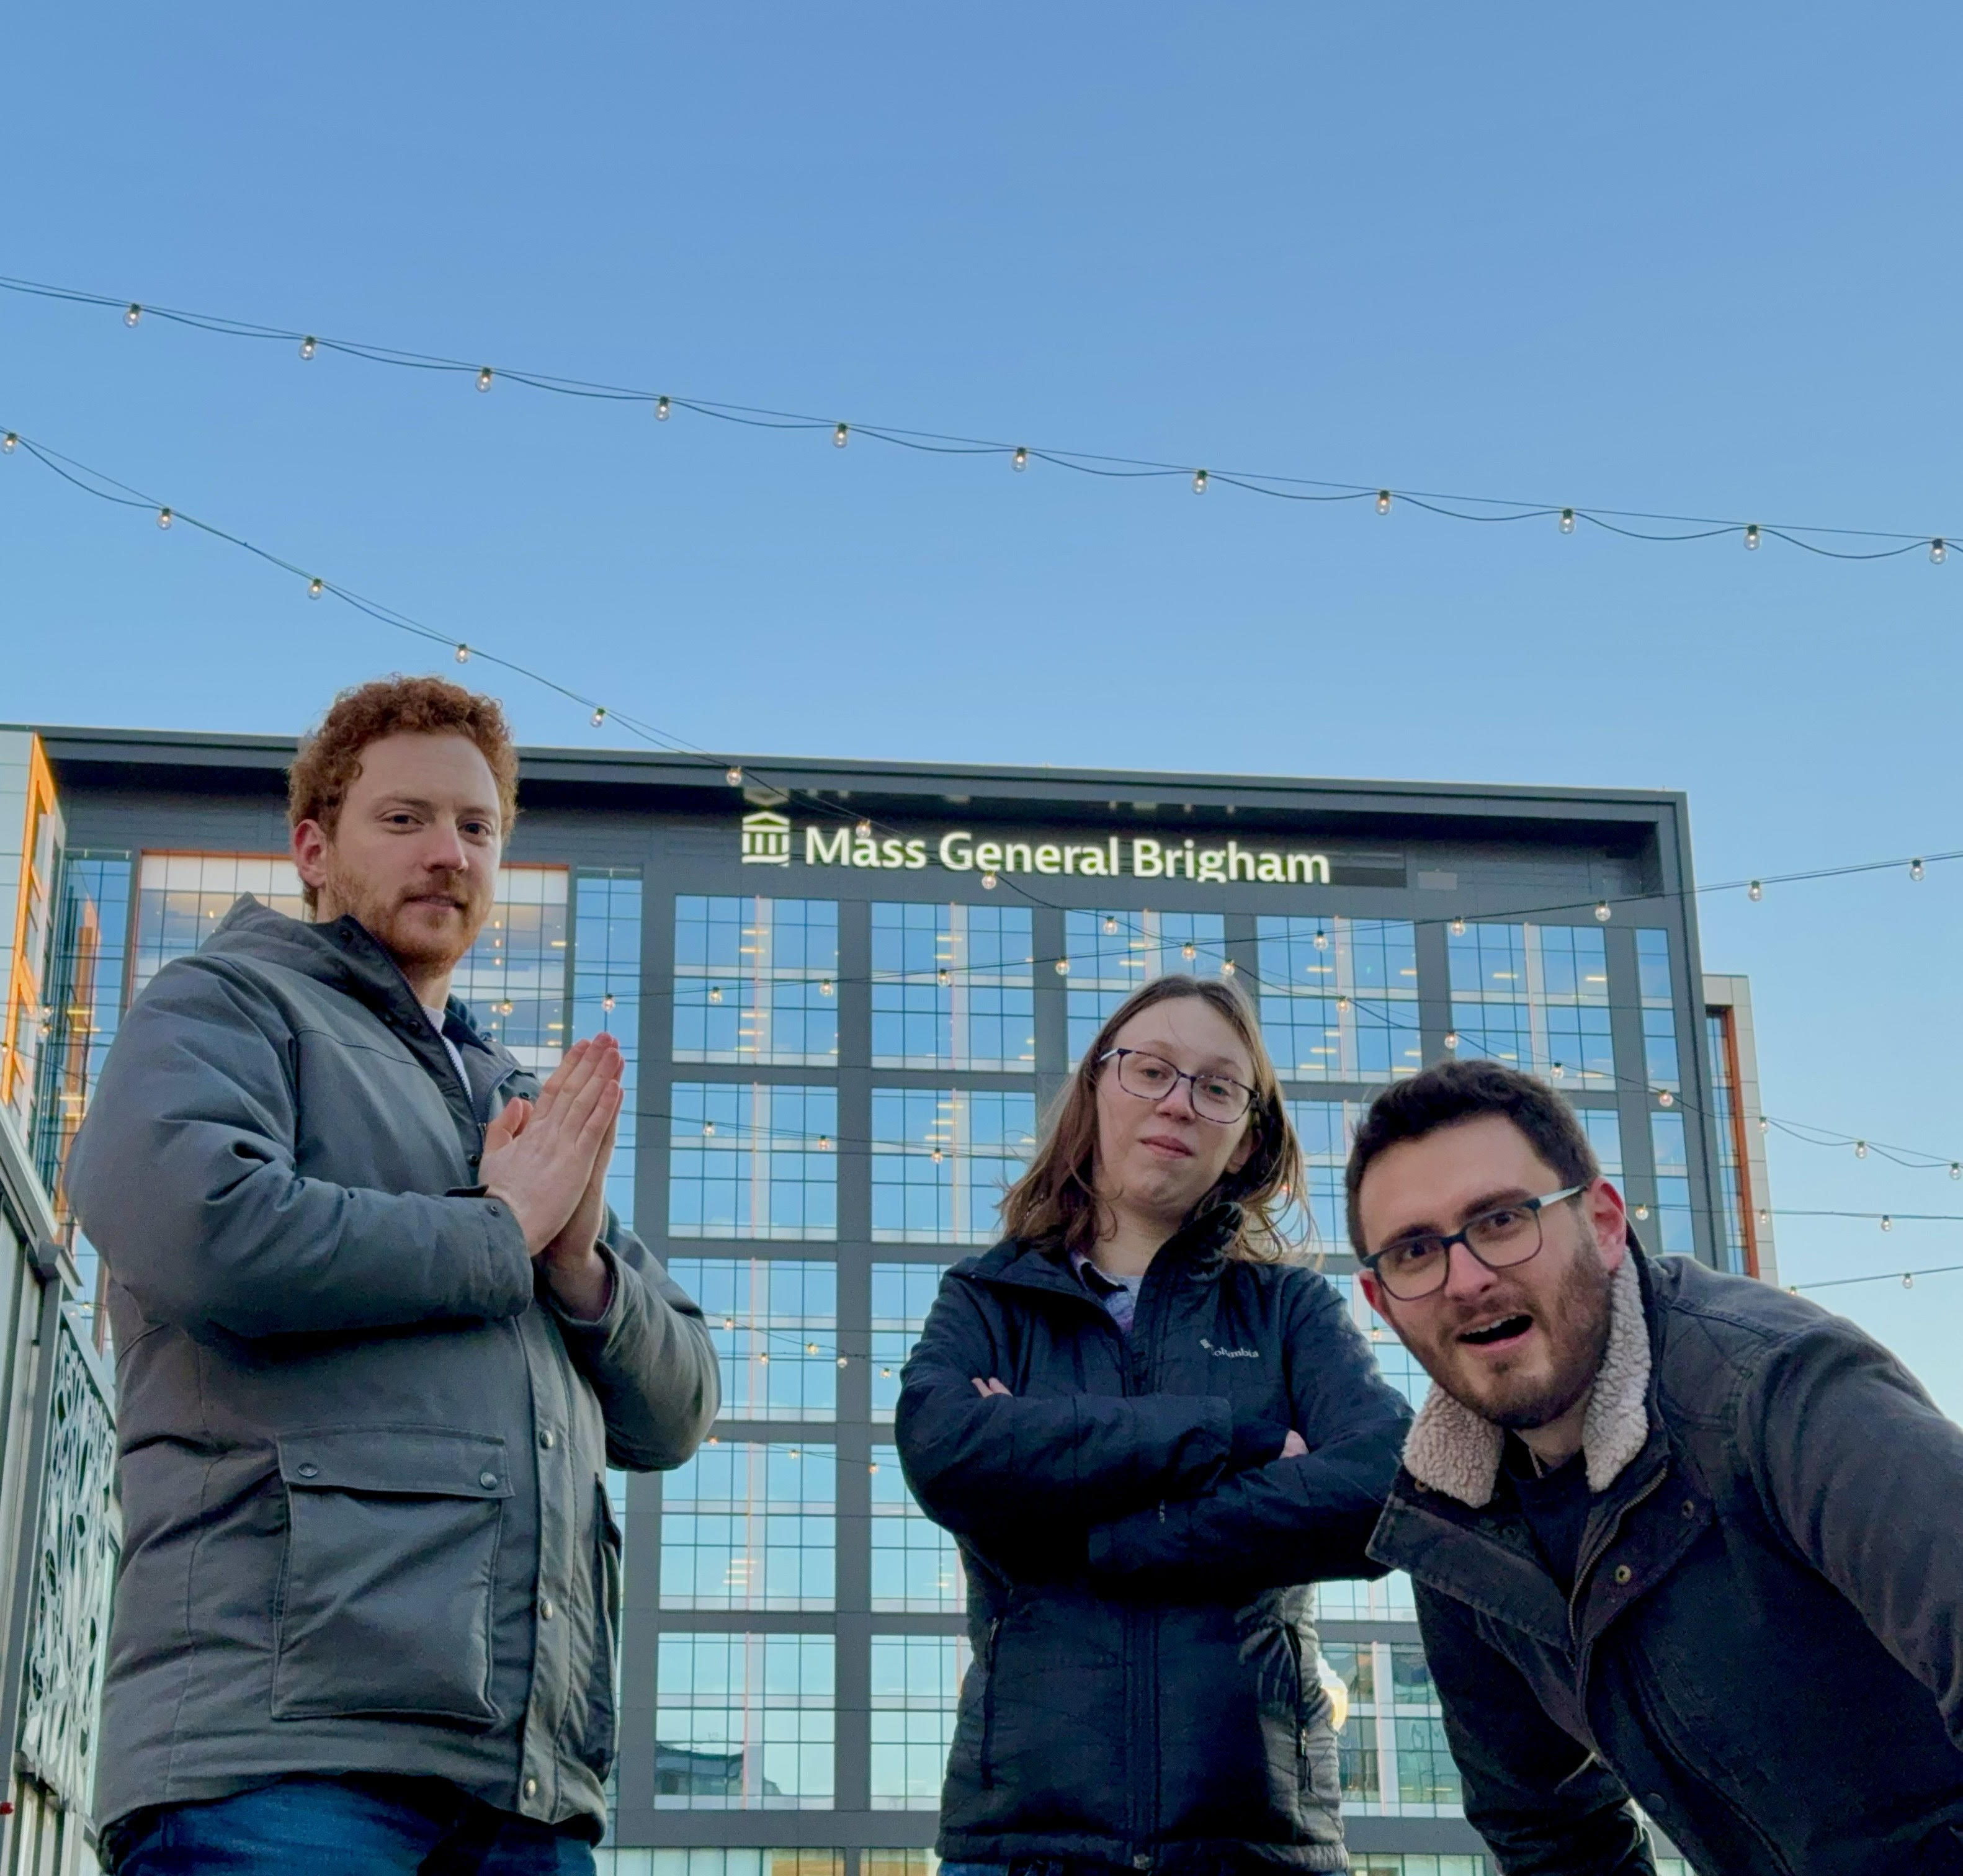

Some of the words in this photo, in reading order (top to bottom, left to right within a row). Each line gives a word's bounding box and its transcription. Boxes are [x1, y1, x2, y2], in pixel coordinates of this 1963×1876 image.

[805, 826, 927, 869] Mass
[939, 832, 1120, 876] General
[1133, 839, 1330, 884] Brigham
